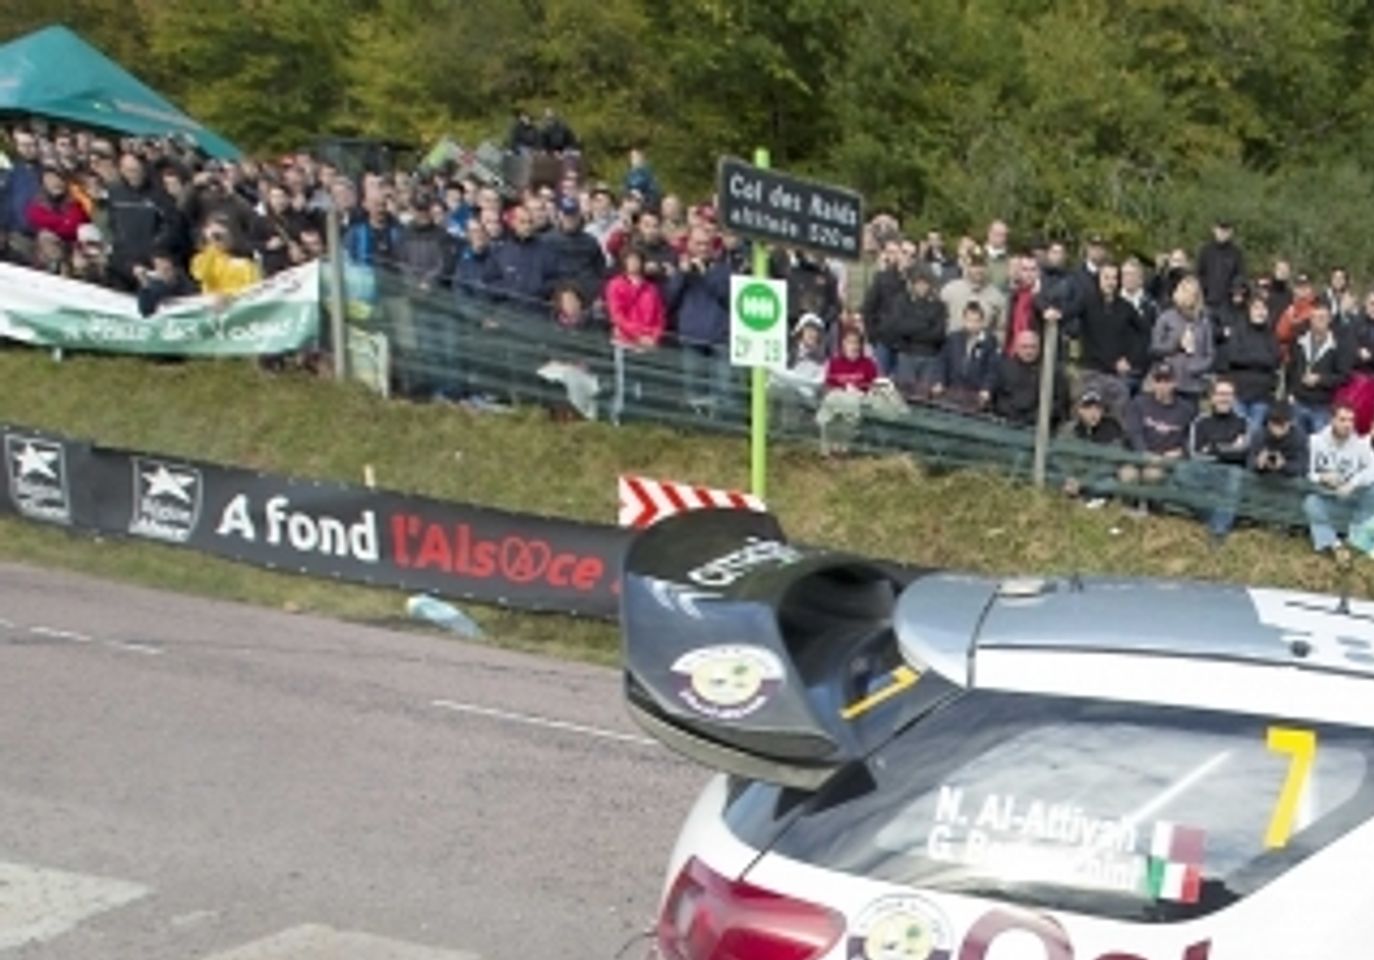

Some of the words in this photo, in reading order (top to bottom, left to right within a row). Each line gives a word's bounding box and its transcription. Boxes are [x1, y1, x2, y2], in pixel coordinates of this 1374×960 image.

[729, 172, 762, 203] Col
[768, 185, 801, 212] des
[215, 495, 254, 541] A
[266, 496, 379, 562] fond
[935, 785, 968, 826] N.
[975, 793, 1137, 853] Al-Attiyah
[1264, 724, 1317, 848] 7
